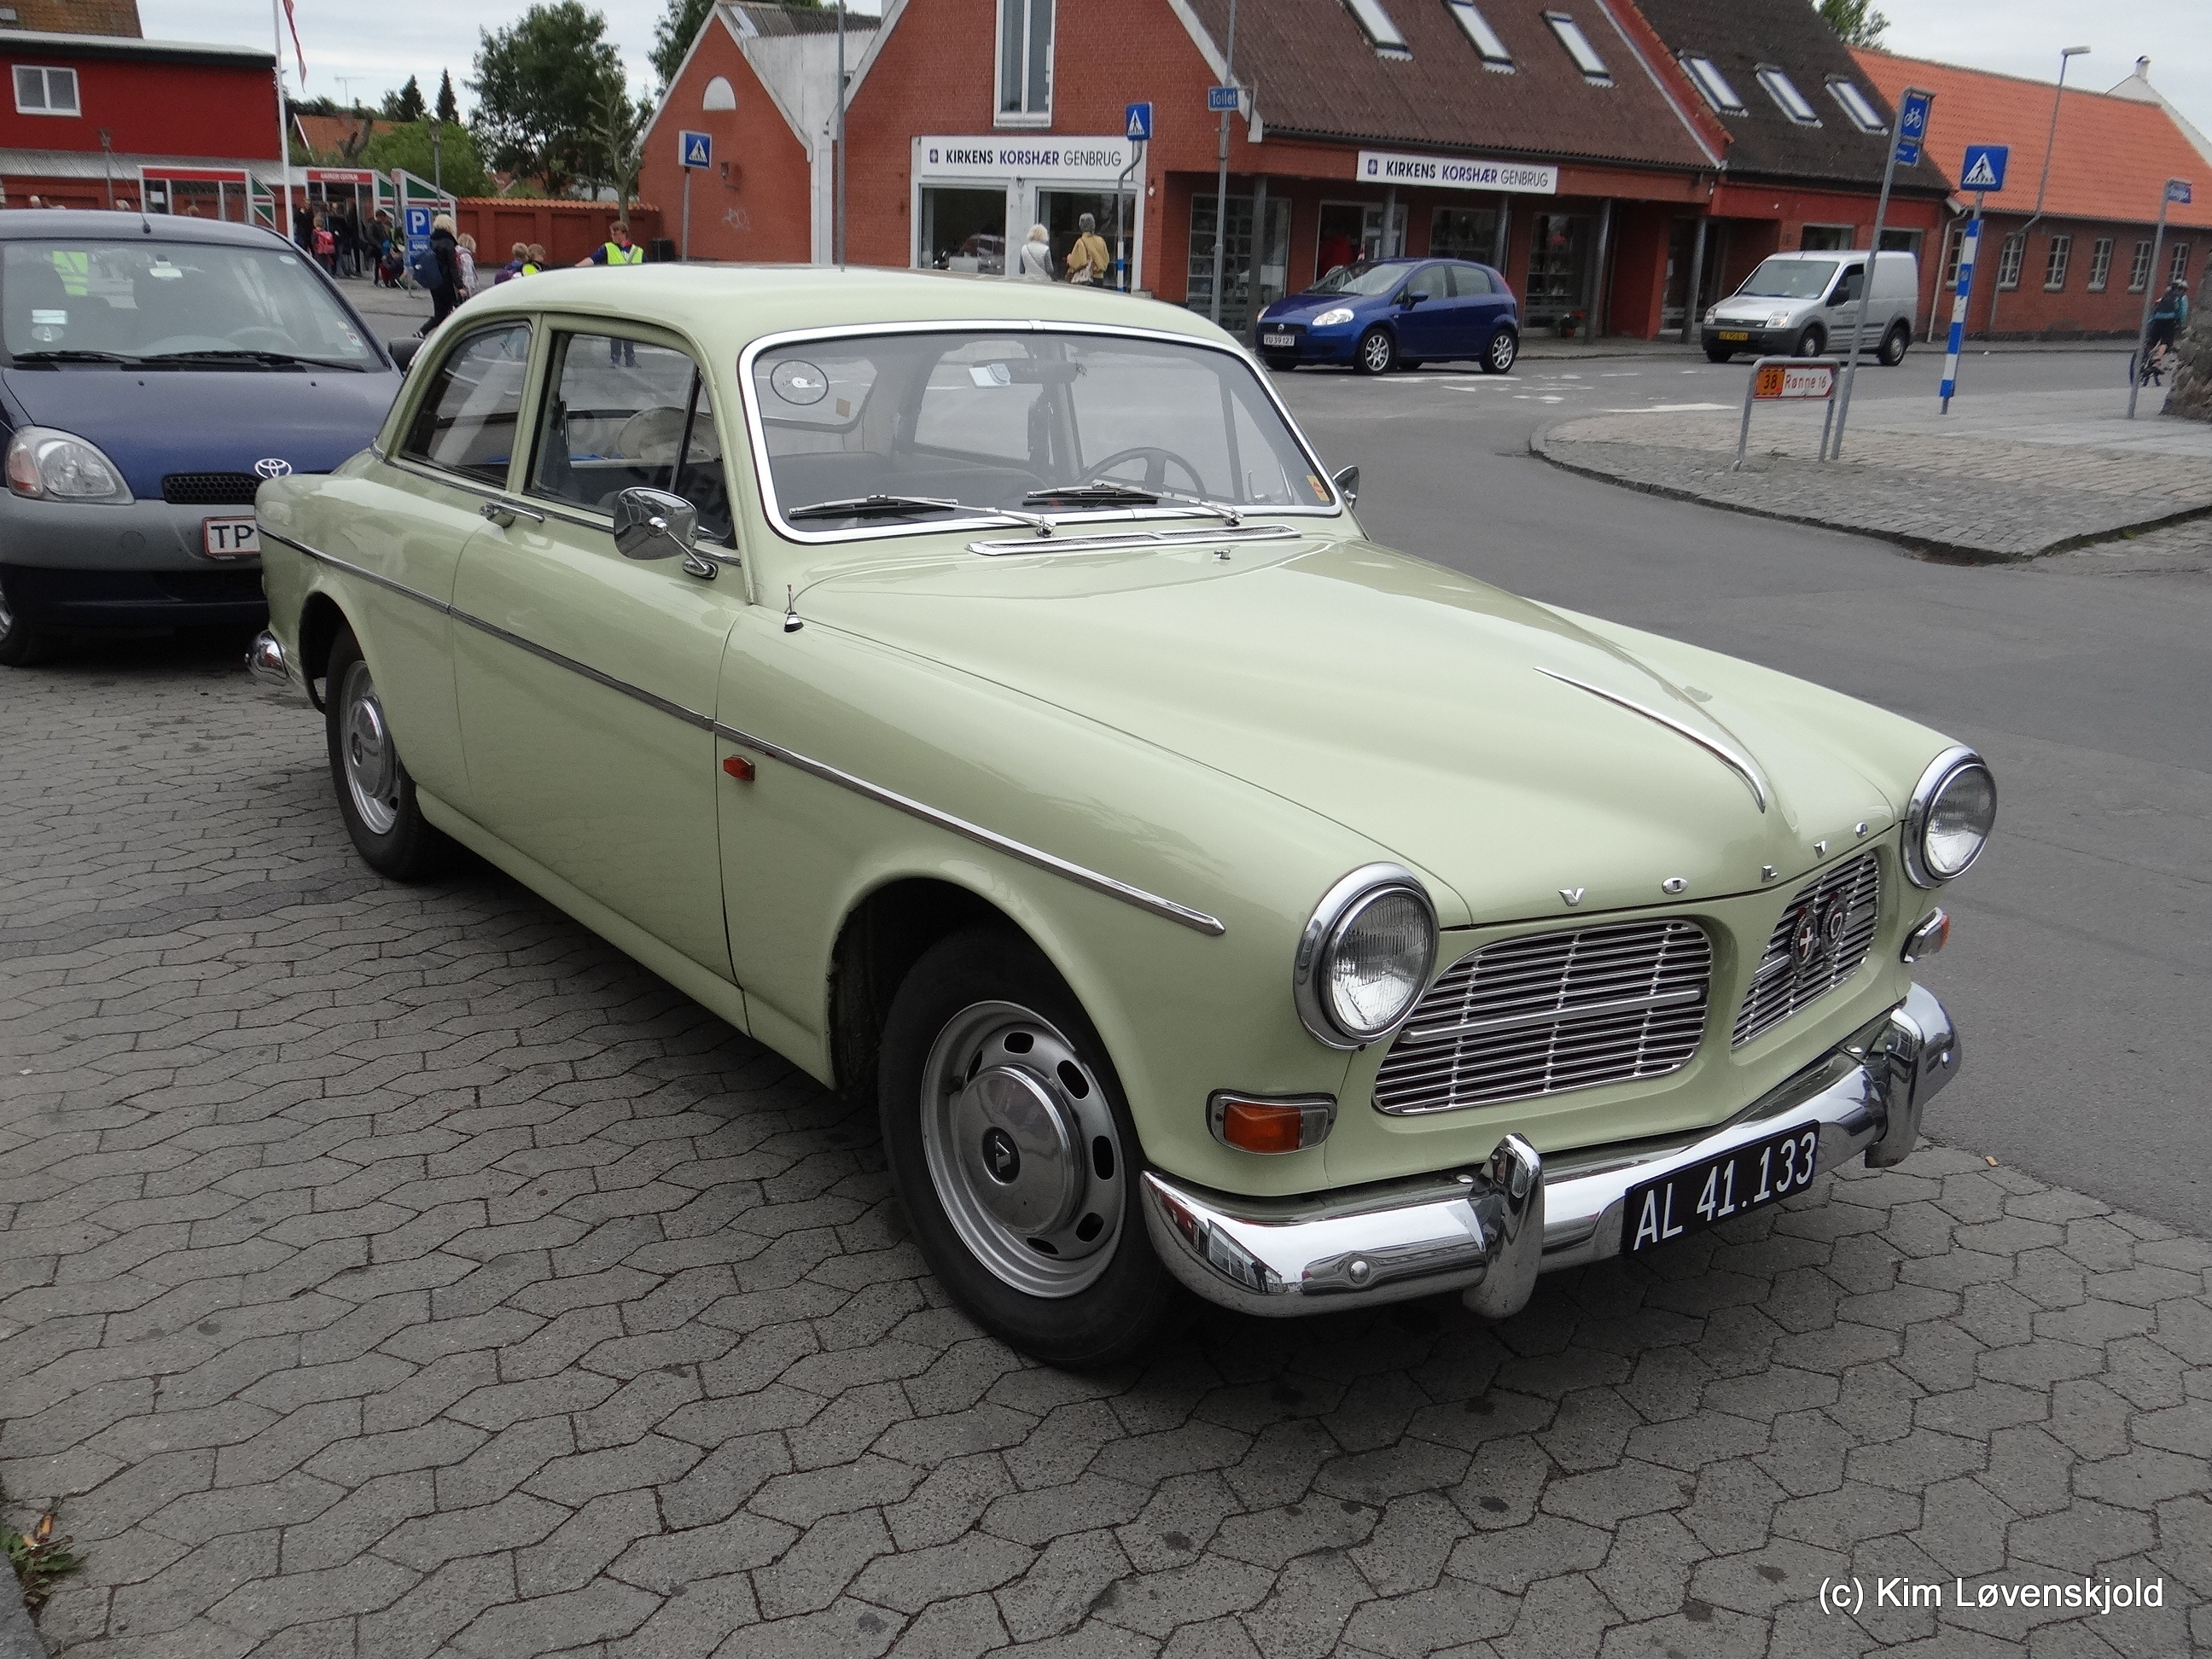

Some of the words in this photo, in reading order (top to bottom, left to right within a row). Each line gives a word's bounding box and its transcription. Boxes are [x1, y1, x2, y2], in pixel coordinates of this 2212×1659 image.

[1211, 90, 1237, 105] Toilet
[946, 149, 993, 165] KIRKENS
[999, 150, 1059, 166] KORSHÆR
[1063, 150, 1121, 166] GENBRUG
[1386, 160, 1436, 179] KIRKENS
[1441, 166, 1498, 183] KORSHÆR
[1500, 168, 1549, 188] GENBRUG
[410, 211, 426, 234] P
[1763, 374, 1778, 389] 38
[1784, 374, 1816, 389] Rønne
[1819, 375, 1827, 388] 16
[210, 524, 253, 549] TP
[1633, 1183, 1683, 1251] AL
[1697, 1132, 1816, 1221] 41.133
